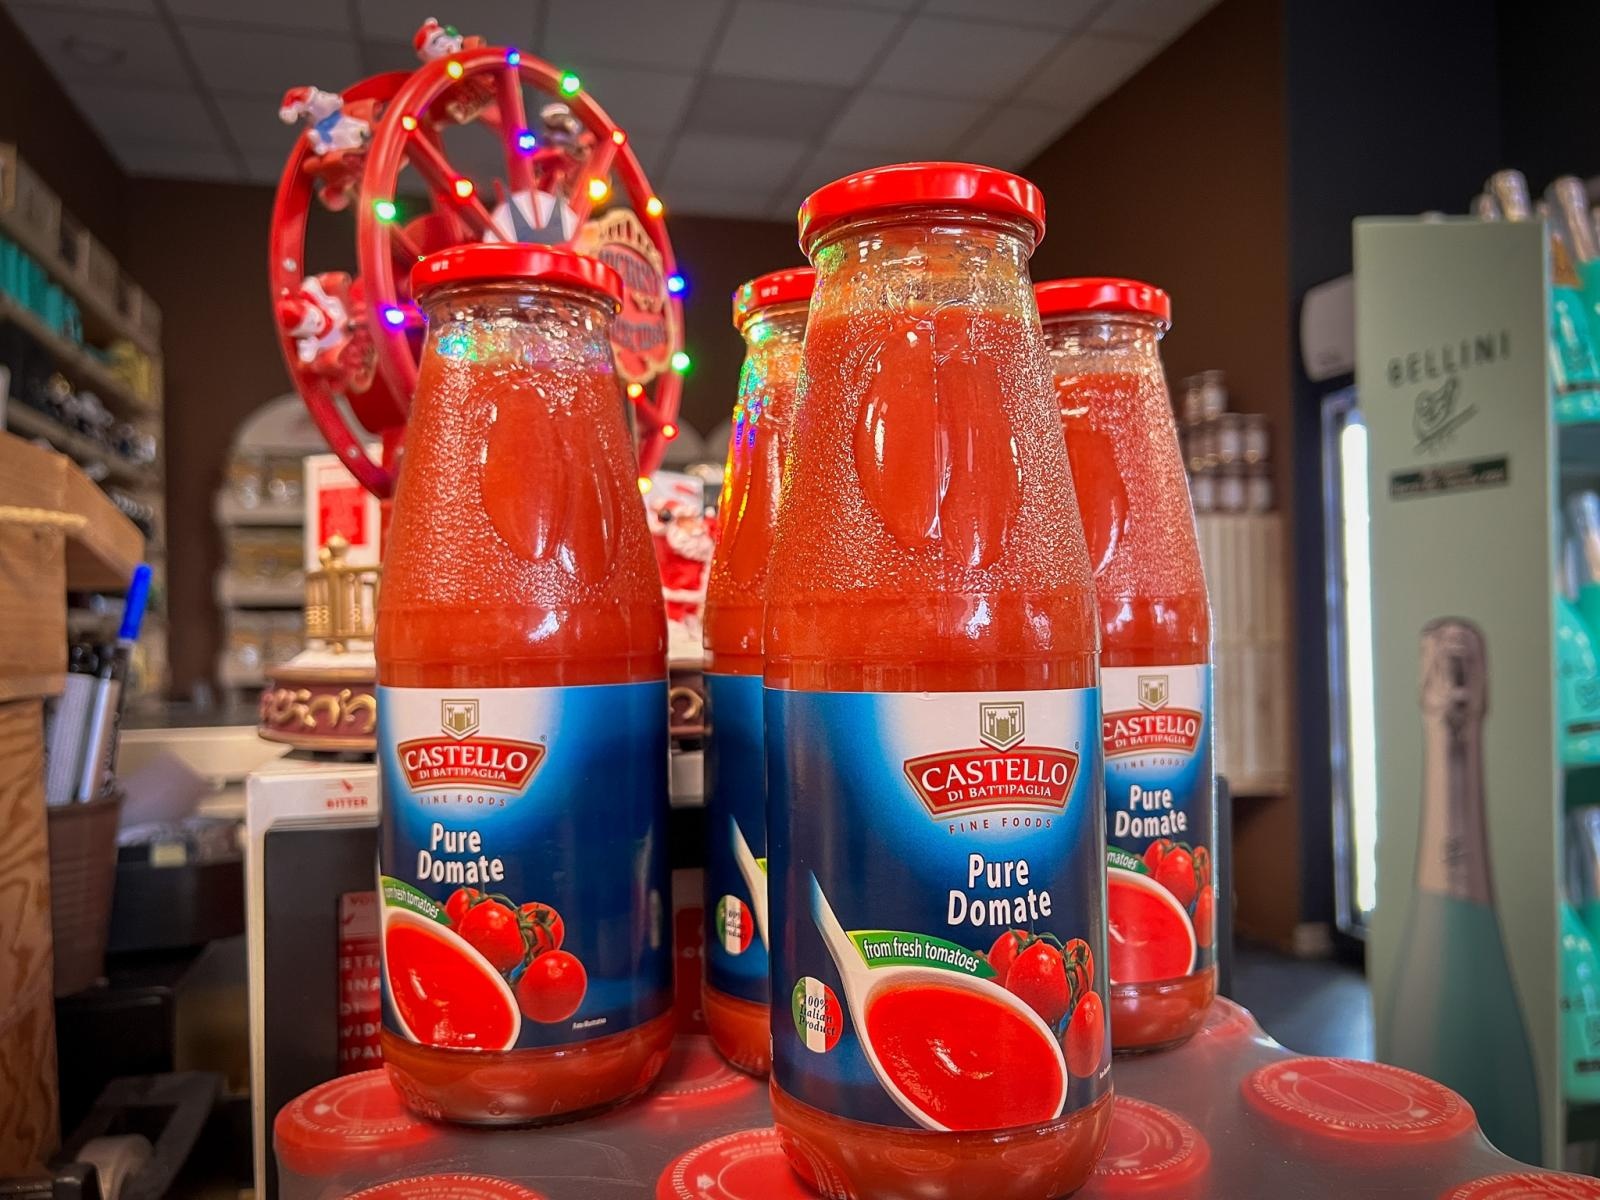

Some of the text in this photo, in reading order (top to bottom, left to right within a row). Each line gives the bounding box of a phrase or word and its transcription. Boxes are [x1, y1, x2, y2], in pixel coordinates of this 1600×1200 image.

[1386, 329, 1511, 388] BELLINI
[1103, 716, 1196, 741] CASTELLO
[1115, 734, 1186, 748] DI BATTIPAGLIA
[405, 745, 528, 772] CASTELLO
[419, 767, 507, 781] DI BATTIPAGLIA
[921, 758, 1068, 792] CASTELLO
[420, 794, 505, 807] FINE FOODS
[947, 784, 1052, 802] DI BATTIPAGLIA
[1129, 784, 1173, 811] Pure
[949, 817, 1052, 834] FINE FOODS
[1114, 809, 1188, 838] Domate
[430, 822, 482, 854] Pure
[416, 850, 505, 884] Domate
[968, 853, 1029, 889] Pure
[1106, 852, 1139, 870] matoes
[406, 891, 440, 918] tomatoes
[947, 888, 1052, 927] Domate
[863, 936, 980, 973] from fresh tomatoes
[798, 1013, 835, 1036] Product
[799, 1004, 833, 1024] Italian
